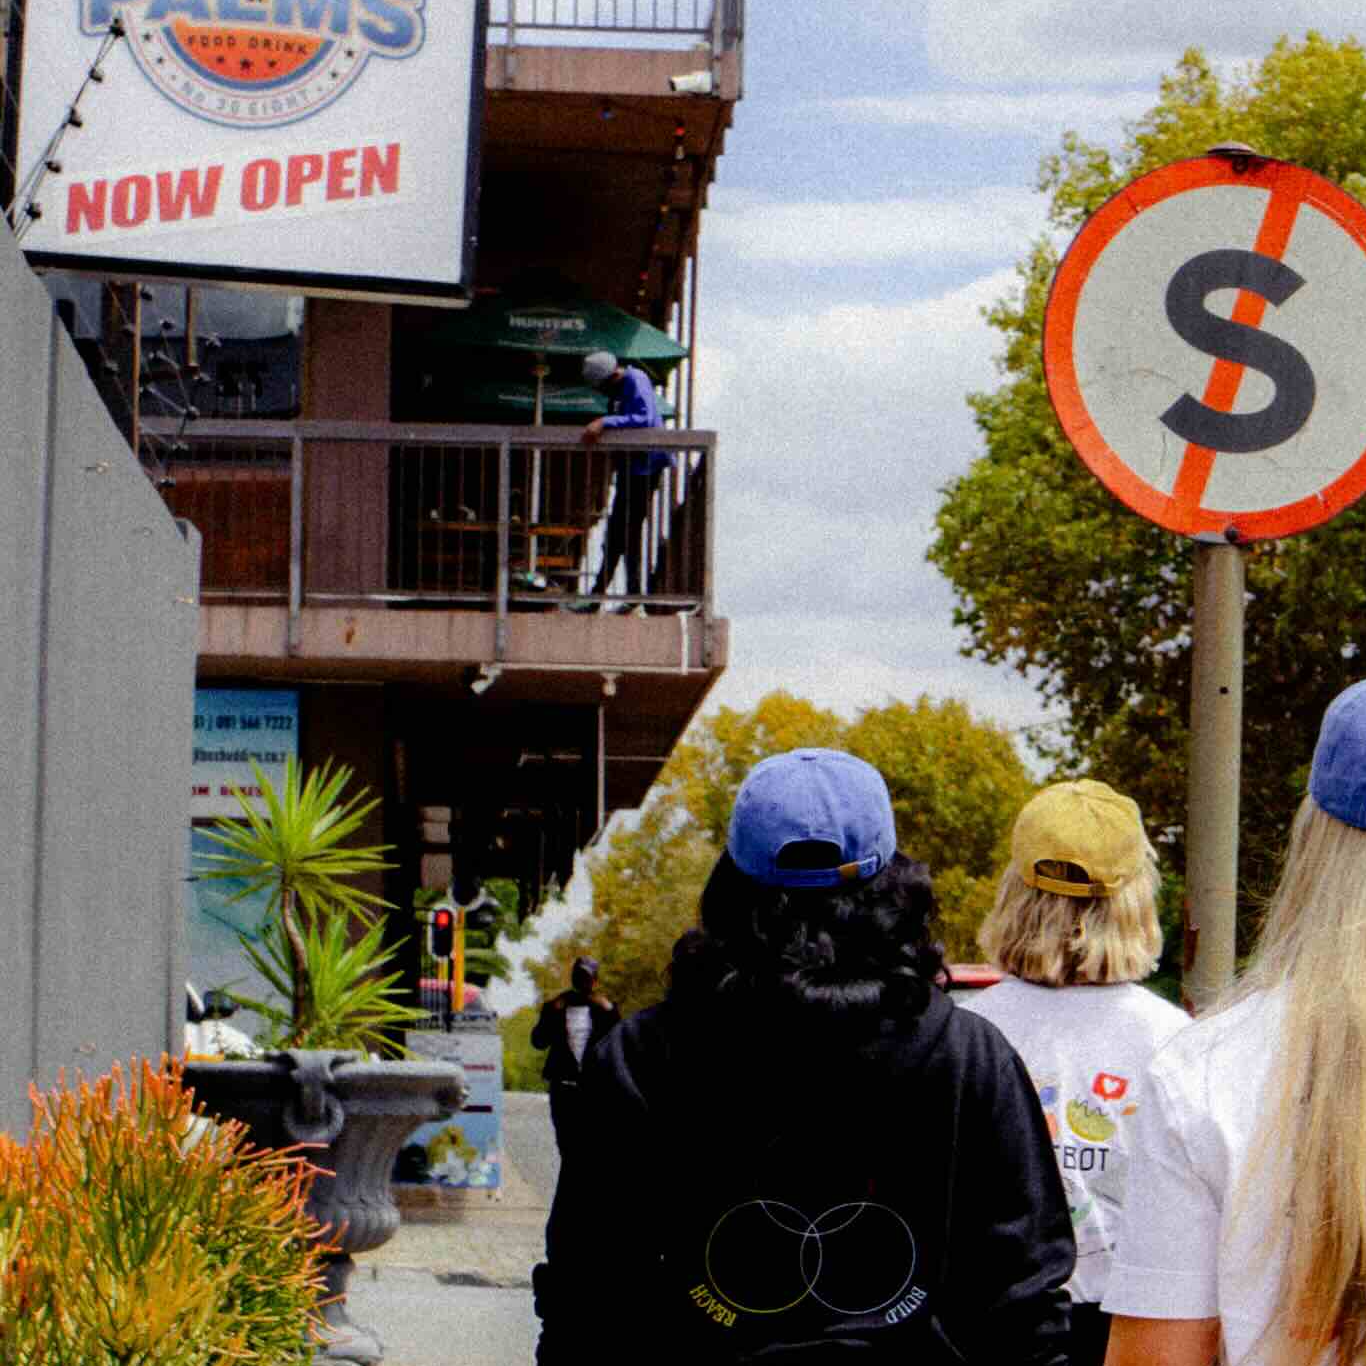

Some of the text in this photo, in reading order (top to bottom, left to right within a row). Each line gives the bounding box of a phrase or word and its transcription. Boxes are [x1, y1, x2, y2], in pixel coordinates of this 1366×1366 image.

[187, 34, 237, 50] FOOD
[66, 142, 401, 235] NOW OPEN
[1160, 248, 1317, 455] S
[690, 1283, 737, 1327] REACH
[885, 1285, 928, 1324] BUILD
